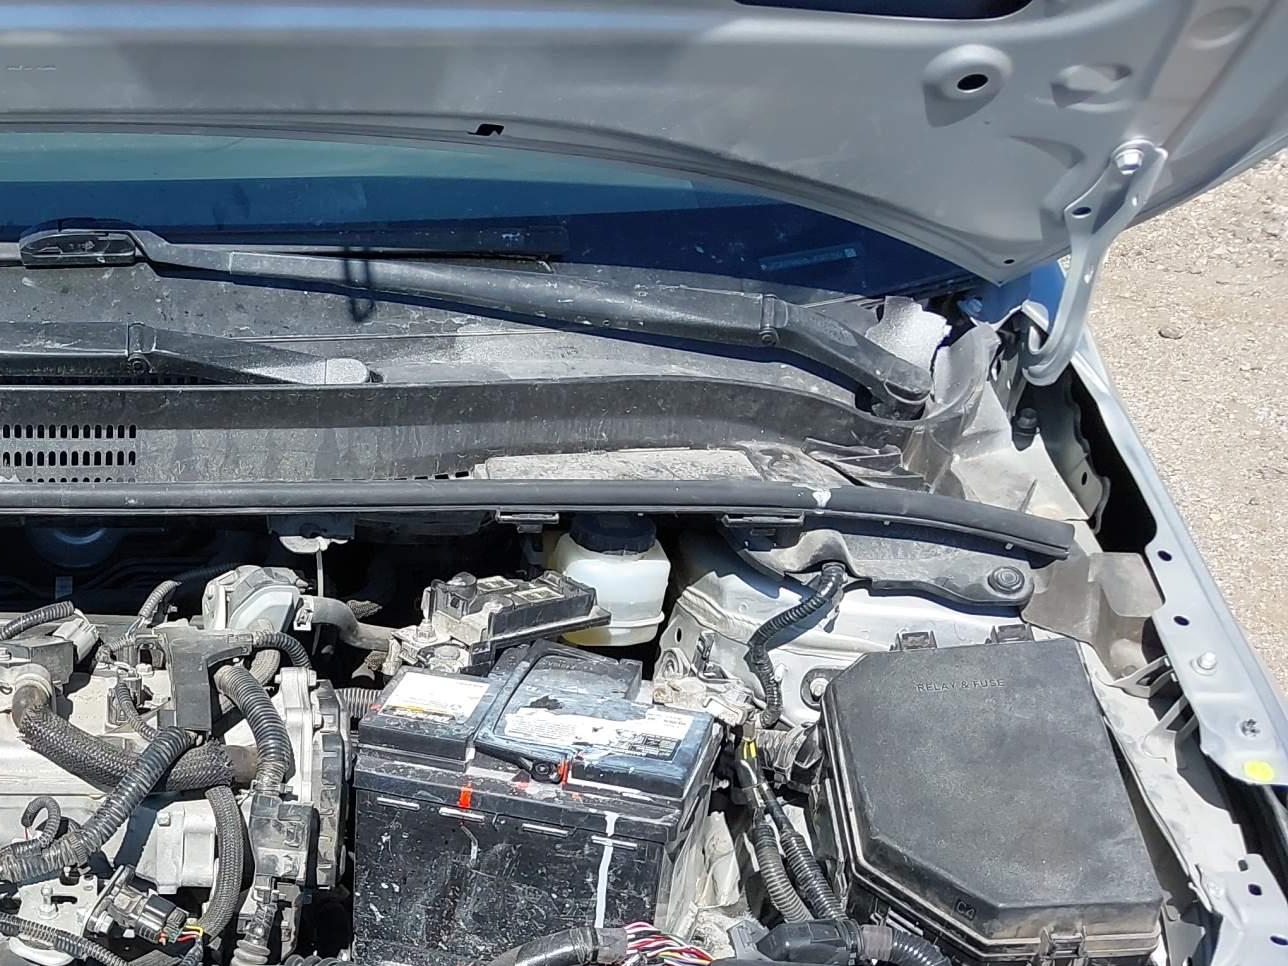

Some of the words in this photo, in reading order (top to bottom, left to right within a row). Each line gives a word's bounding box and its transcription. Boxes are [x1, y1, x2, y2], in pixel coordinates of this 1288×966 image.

[916, 682, 956, 692] RELAY
[961, 680, 969, 689] &
[973, 679, 1005, 688] FUSE
